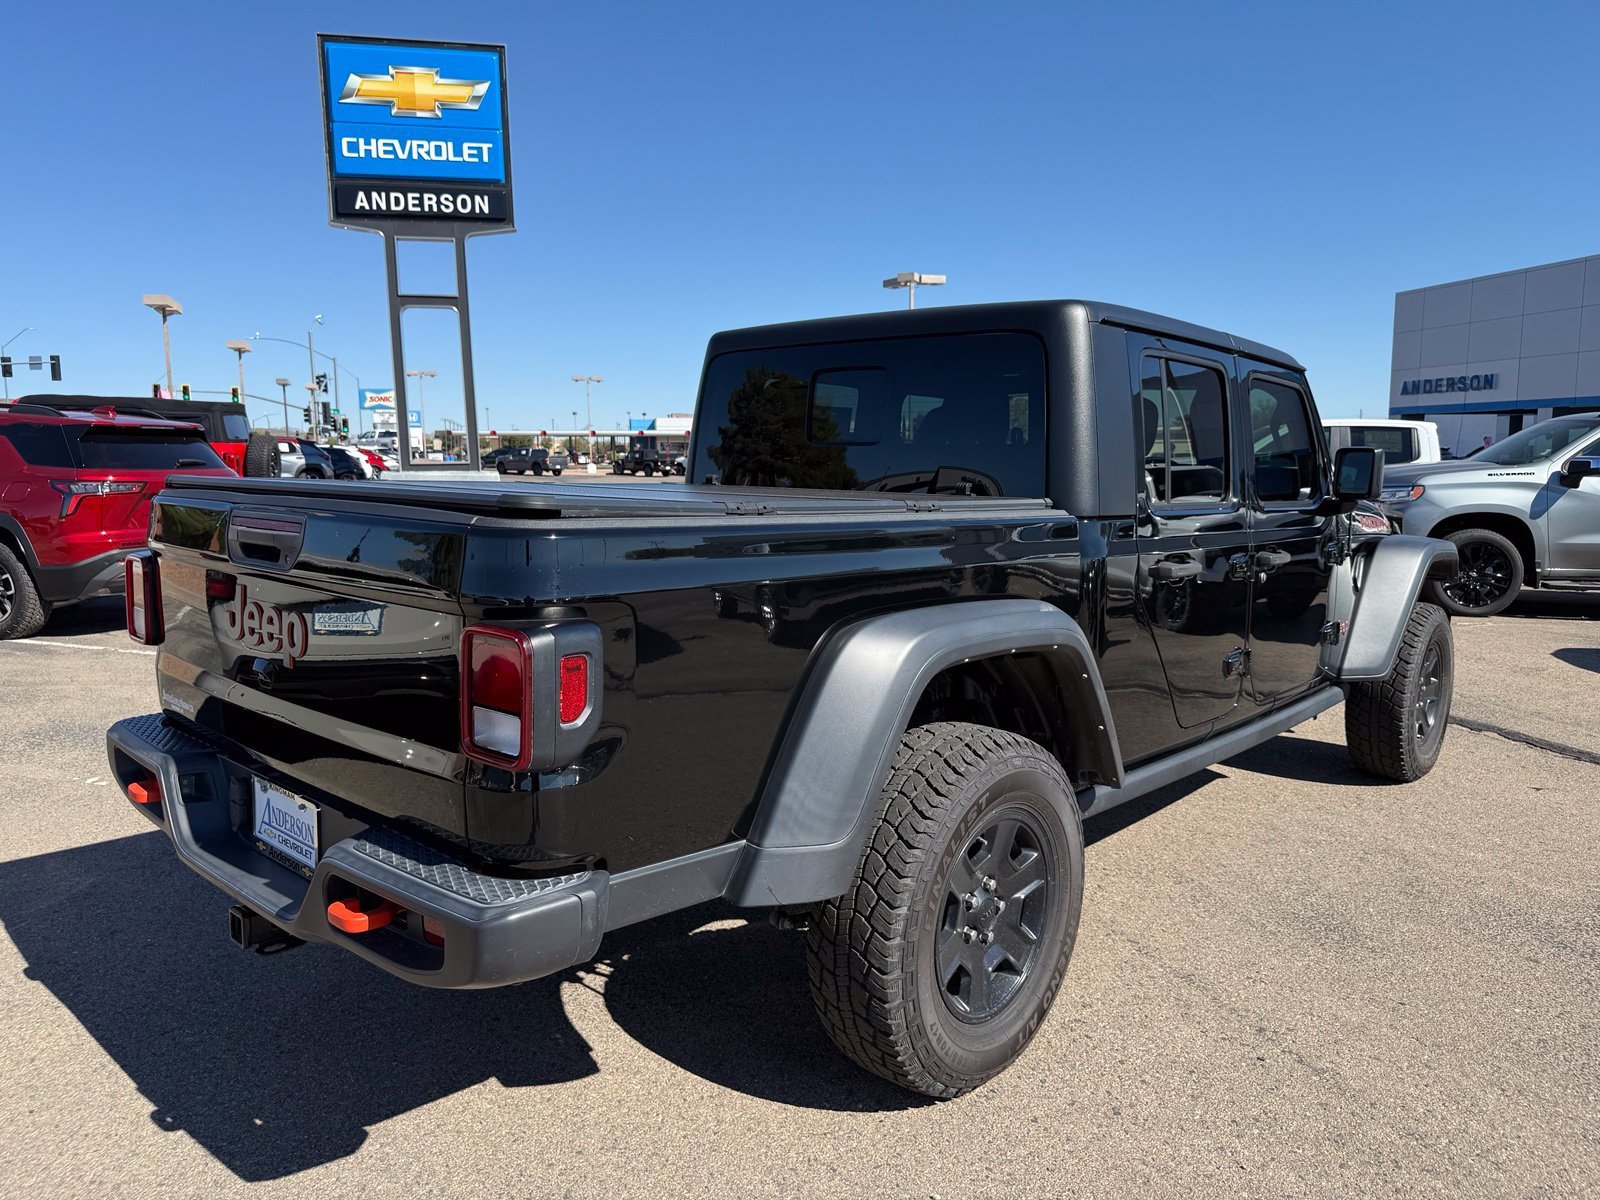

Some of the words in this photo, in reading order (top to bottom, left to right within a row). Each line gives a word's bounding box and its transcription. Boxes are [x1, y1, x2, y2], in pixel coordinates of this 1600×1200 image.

[341, 137, 493, 163] CHEVROLET
[354, 191, 490, 214] ANDERSON
[1400, 374, 1497, 396] ANDERSON
[224, 584, 309, 670] Jeep
[268, 784, 296, 801] KINGMAN
[258, 798, 315, 845] ANDERSON
[269, 845, 301, 873] Anderson
[277, 834, 313, 860] CHEVROLET
[924, 791, 991, 933] FINALIST
[1016, 1011, 1039, 1050] A/T
